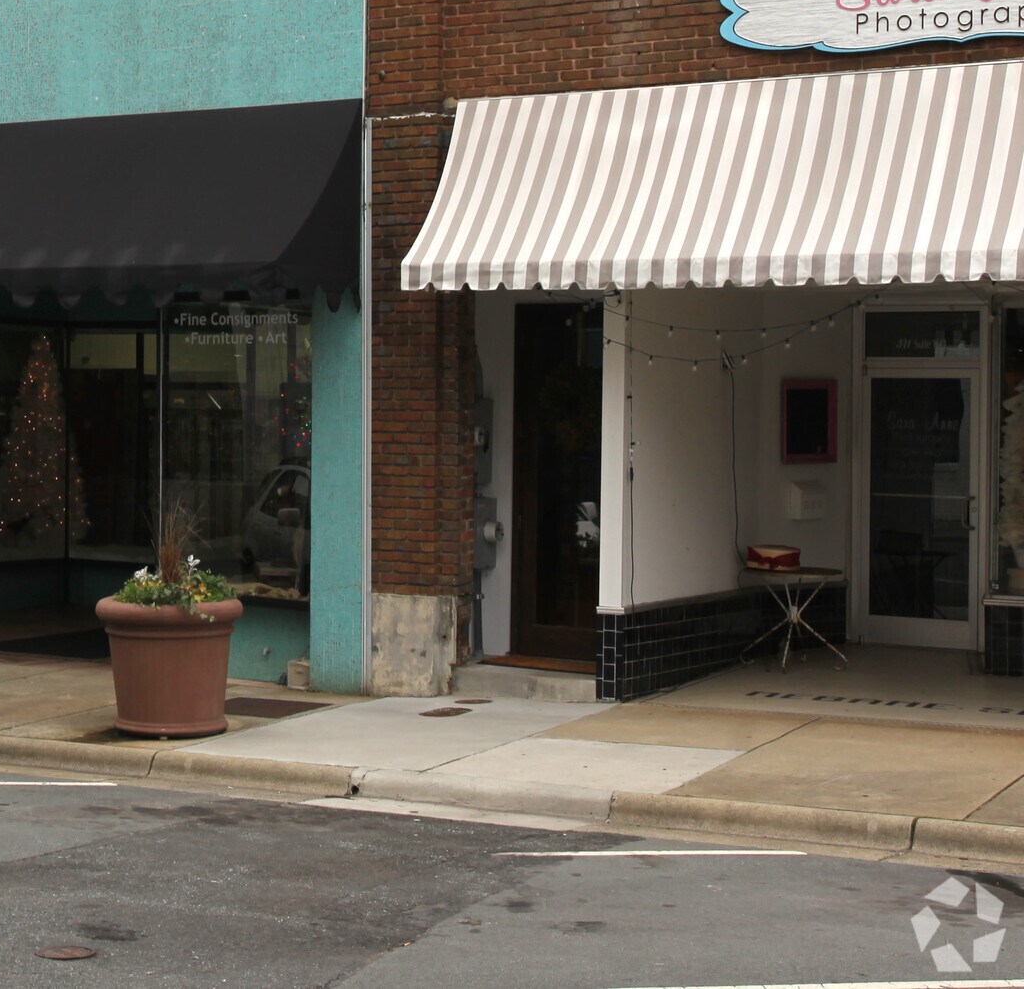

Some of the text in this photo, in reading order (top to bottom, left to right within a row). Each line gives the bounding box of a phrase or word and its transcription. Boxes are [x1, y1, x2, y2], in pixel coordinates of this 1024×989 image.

[180, 312, 298, 328] Fine Consignments
[191, 331, 287, 345] Furniture Art
